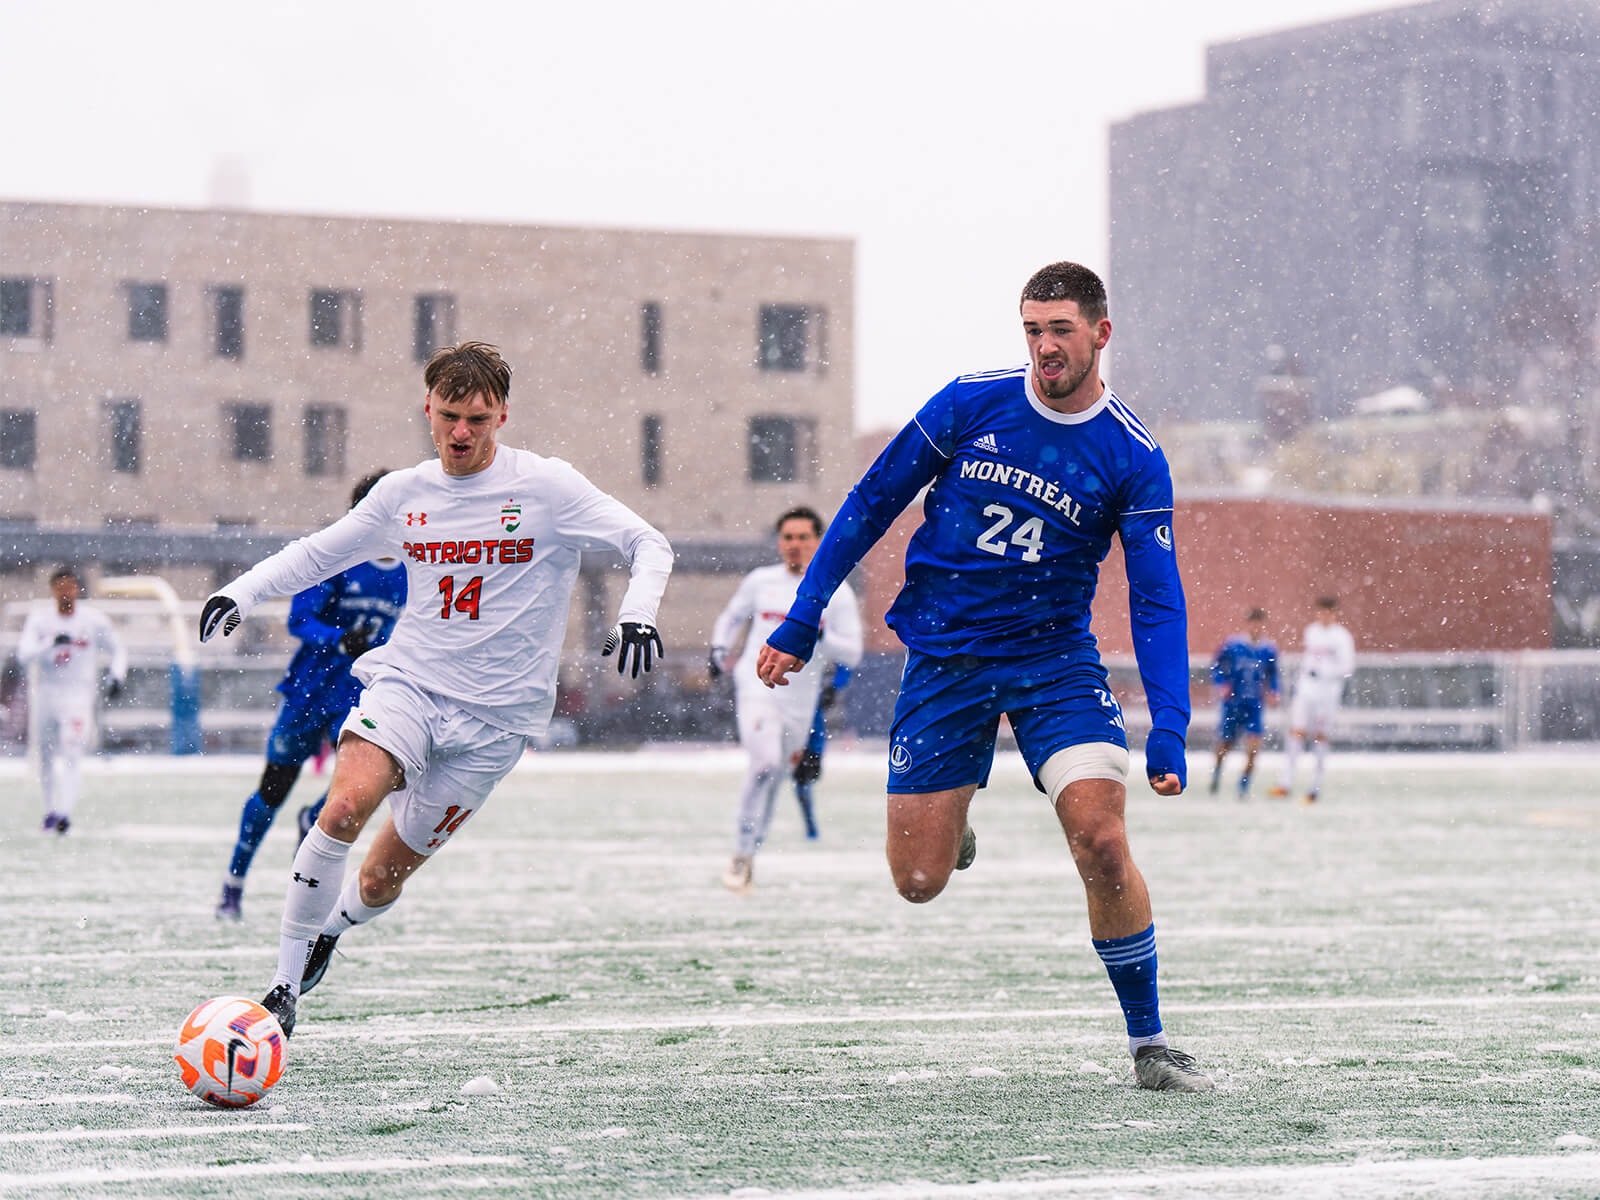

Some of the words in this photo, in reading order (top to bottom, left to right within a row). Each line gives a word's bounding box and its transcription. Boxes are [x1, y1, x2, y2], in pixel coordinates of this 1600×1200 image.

[973, 440, 998, 454] adidas
[960, 460, 1081, 526] MONTRÉAL
[976, 503, 1044, 563] 24
[438, 575, 483, 620] 14
[433, 804, 472, 835] 14
